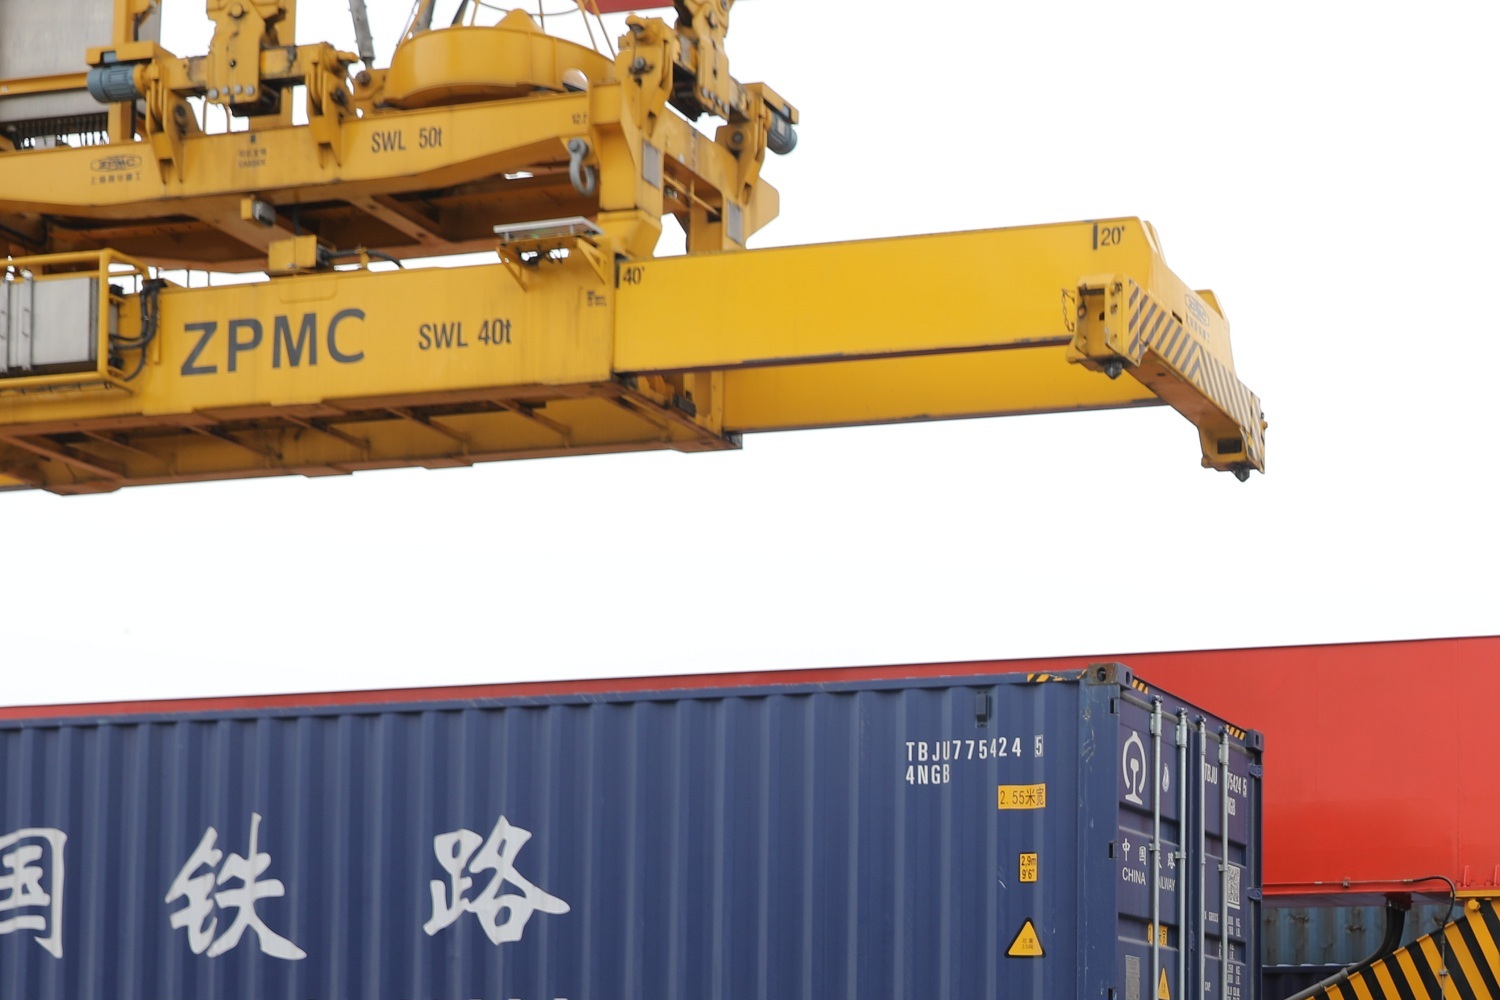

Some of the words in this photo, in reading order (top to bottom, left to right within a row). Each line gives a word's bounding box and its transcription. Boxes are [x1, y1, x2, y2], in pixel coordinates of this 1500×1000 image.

[372, 129, 406, 153] SWL
[419, 127, 442, 148] 50t
[180, 308, 366, 376] ZPMC
[419, 322, 468, 350] SWL
[478, 318, 512, 346] 40t
[906, 737, 1022, 762] TBJU775424
[1035, 735, 1044, 757] 5
[905, 763, 950, 785] 4NGB
[1122, 838, 1176, 870] 中国路
[0, 811, 571, 960] 国铁路
[1122, 867, 1146, 886] CHINA
